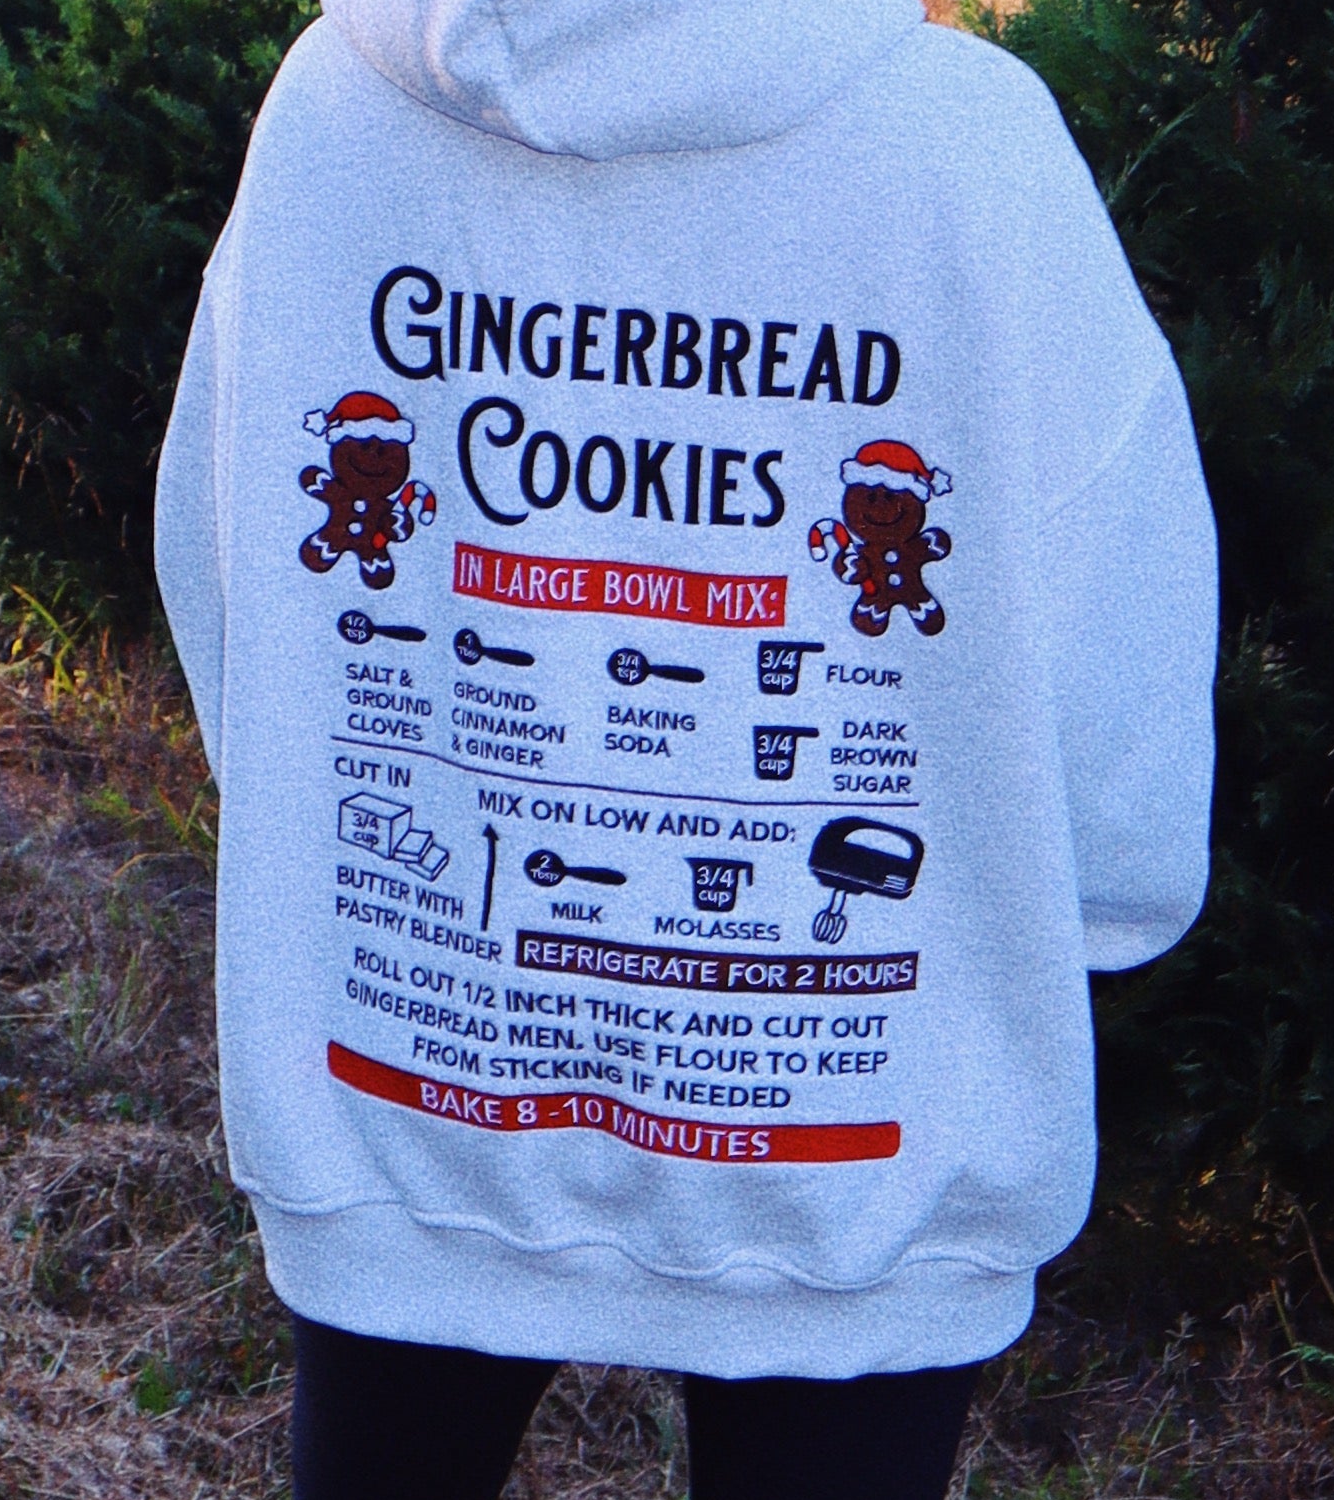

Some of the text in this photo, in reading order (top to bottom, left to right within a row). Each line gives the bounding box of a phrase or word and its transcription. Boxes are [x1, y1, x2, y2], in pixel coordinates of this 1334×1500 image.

[370, 265, 900, 406] GINGERBREAD
[457, 397, 786, 527] COOKIES
[459, 551, 777, 621] IN LARGE BOWL MIX:
[345, 615, 366, 627] 1/2
[345, 628, 367, 641] tsp
[616, 652, 639, 667] 3/4
[760, 650, 797, 670] 3/4
[346, 663, 414, 688] SALT &
[616, 667, 639, 681] tsp
[762, 673, 794, 689] cup
[826, 665, 903, 689] FLOUR
[347, 689, 432, 716] GROUND
[453, 682, 537, 712] GROUND
[347, 713, 423, 741] CLOVES
[451, 708, 565, 744] CINNAMON
[607, 705, 696, 732] BAKING
[604, 732, 671, 757] SODA
[757, 734, 793, 755] 3/4
[842, 721, 907, 743] DARK
[451, 734, 544, 769] & GINGER
[829, 747, 917, 768] BROWN
[334, 756, 411, 788] CUT IN
[758, 758, 790, 774] cup
[833, 775, 912, 795] SUGAR
[352, 812, 380, 831] 3/4
[478, 789, 796, 843] MIX ON LOW AND ADD:
[353, 831, 380, 847] cup
[540, 854, 550, 869] 2
[696, 865, 735, 888] 3/4
[336, 865, 464, 921] BUTTER WITH
[698, 888, 732, 907] cup
[551, 902, 604, 924] MILK
[335, 895, 503, 964] PASTRY BLENDER
[653, 916, 780, 942] MOLASSES
[522, 939, 914, 989] REFRIGERATE FOR 2 HOURS
[354, 946, 888, 1038] ROLL OUT 1/2 INCH THICK AND CUT OUT
[346, 978, 888, 1077] GINGERBREAD MEN. USE FLOUR TO KEEP
[412, 1035, 791, 1109] FROM STICKING IF NEEDED
[419, 1081, 503, 1125] BAKE
[517, 1100, 538, 1124] 8
[613, 1106, 771, 1157] MINUTES
